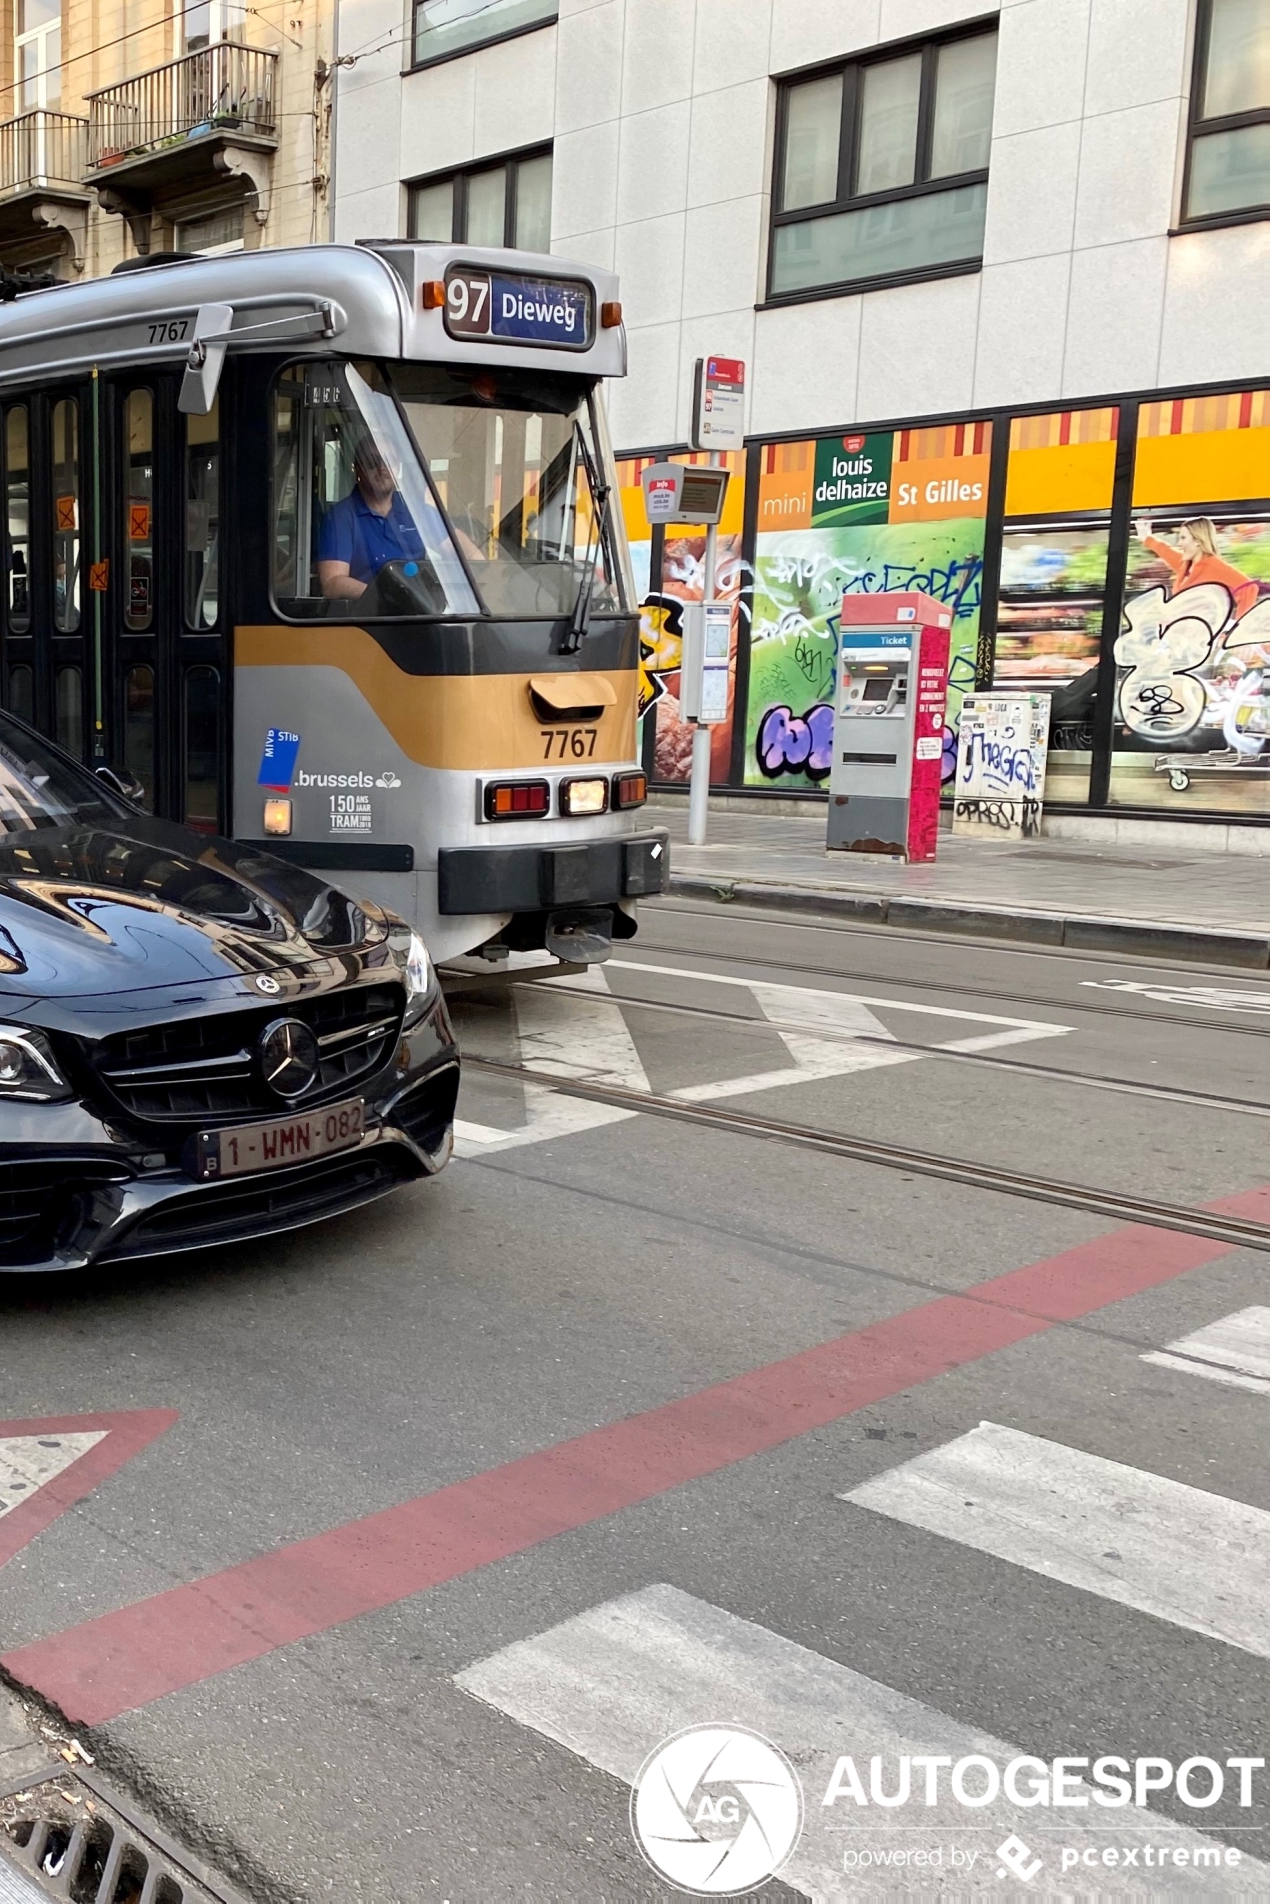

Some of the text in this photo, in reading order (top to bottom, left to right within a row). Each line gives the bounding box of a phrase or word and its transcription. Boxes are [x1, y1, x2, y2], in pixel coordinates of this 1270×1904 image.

[447, 278, 576, 332] 97 Dieweg
[148, 320, 189, 344] 7767
[832, 454, 873, 477] louis
[815, 478, 888, 502] delhaize
[898, 479, 983, 506] St Gilles
[763, 492, 807, 516] mini
[880, 636, 908, 645] Ticket
[277, 731, 299, 742] STIB
[541, 729, 598, 759] 7767
[329, 795, 369, 813] 150 ANS
[355, 804, 372, 812] JAAR
[330, 815, 359, 828] TRAM
[228, 1106, 362, 1166] 1-WMN-082
[206, 1157, 217, 1171] B
